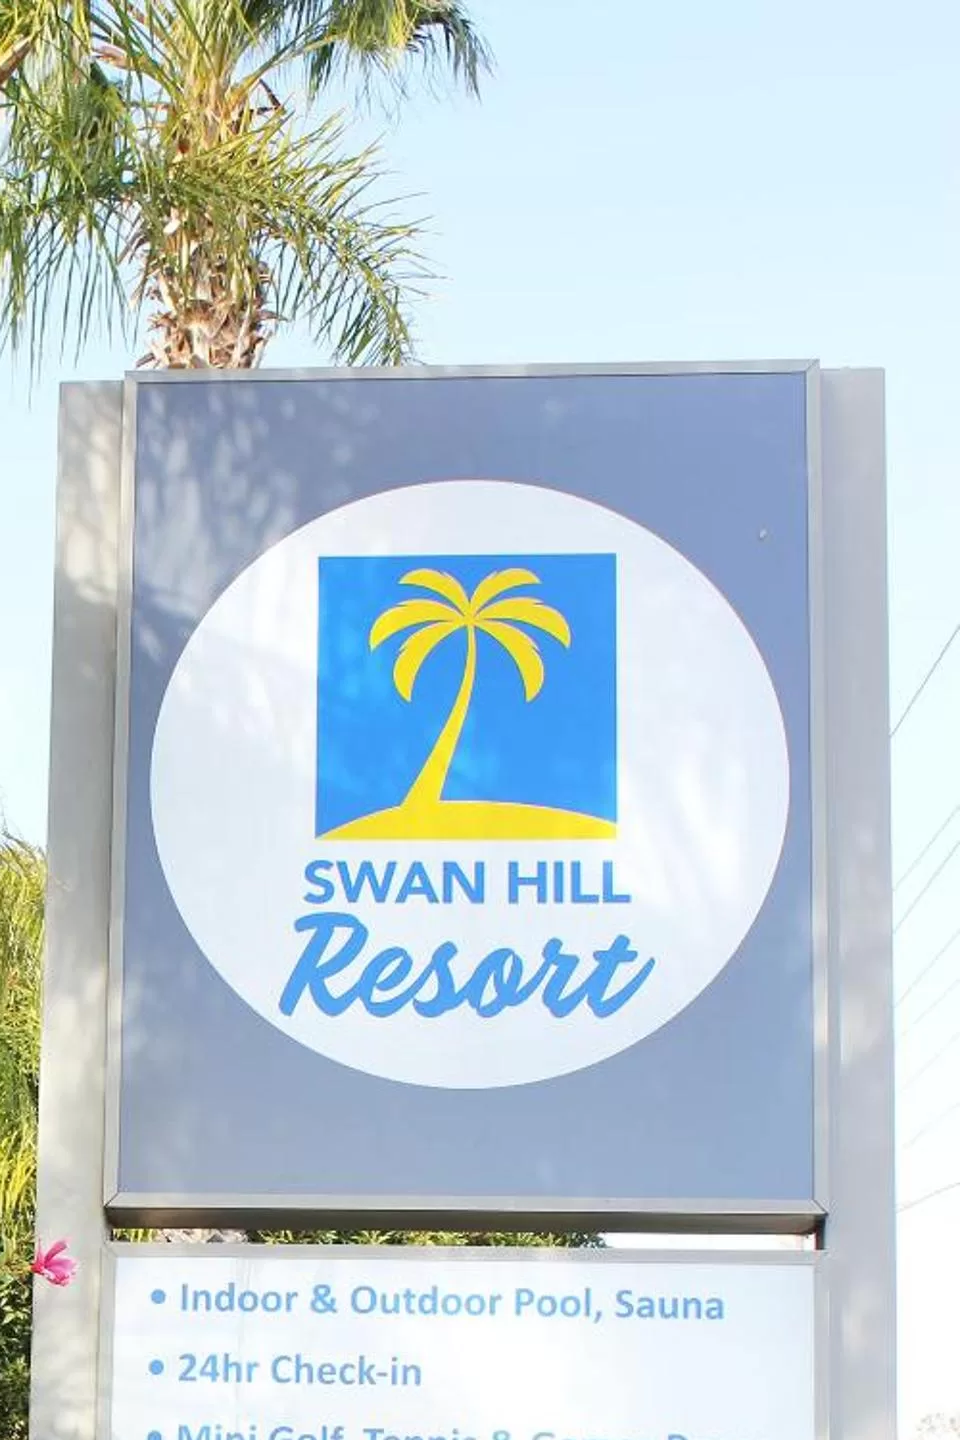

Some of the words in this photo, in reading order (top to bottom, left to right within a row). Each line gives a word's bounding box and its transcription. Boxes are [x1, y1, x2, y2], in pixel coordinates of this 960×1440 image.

[303, 860, 485, 904] SWAN
[508, 860, 632, 904] HILL
[278, 911, 656, 1018] Resort
[178, 1282, 299, 1315] Indoor
[309, 1284, 339, 1314] &
[350, 1284, 499, 1318] Outdoor
[513, 1287, 605, 1325] Pool,
[614, 1288, 726, 1322] Sauna
[176, 1353, 260, 1383] 24hr
[270, 1354, 423, 1387] Check-in
